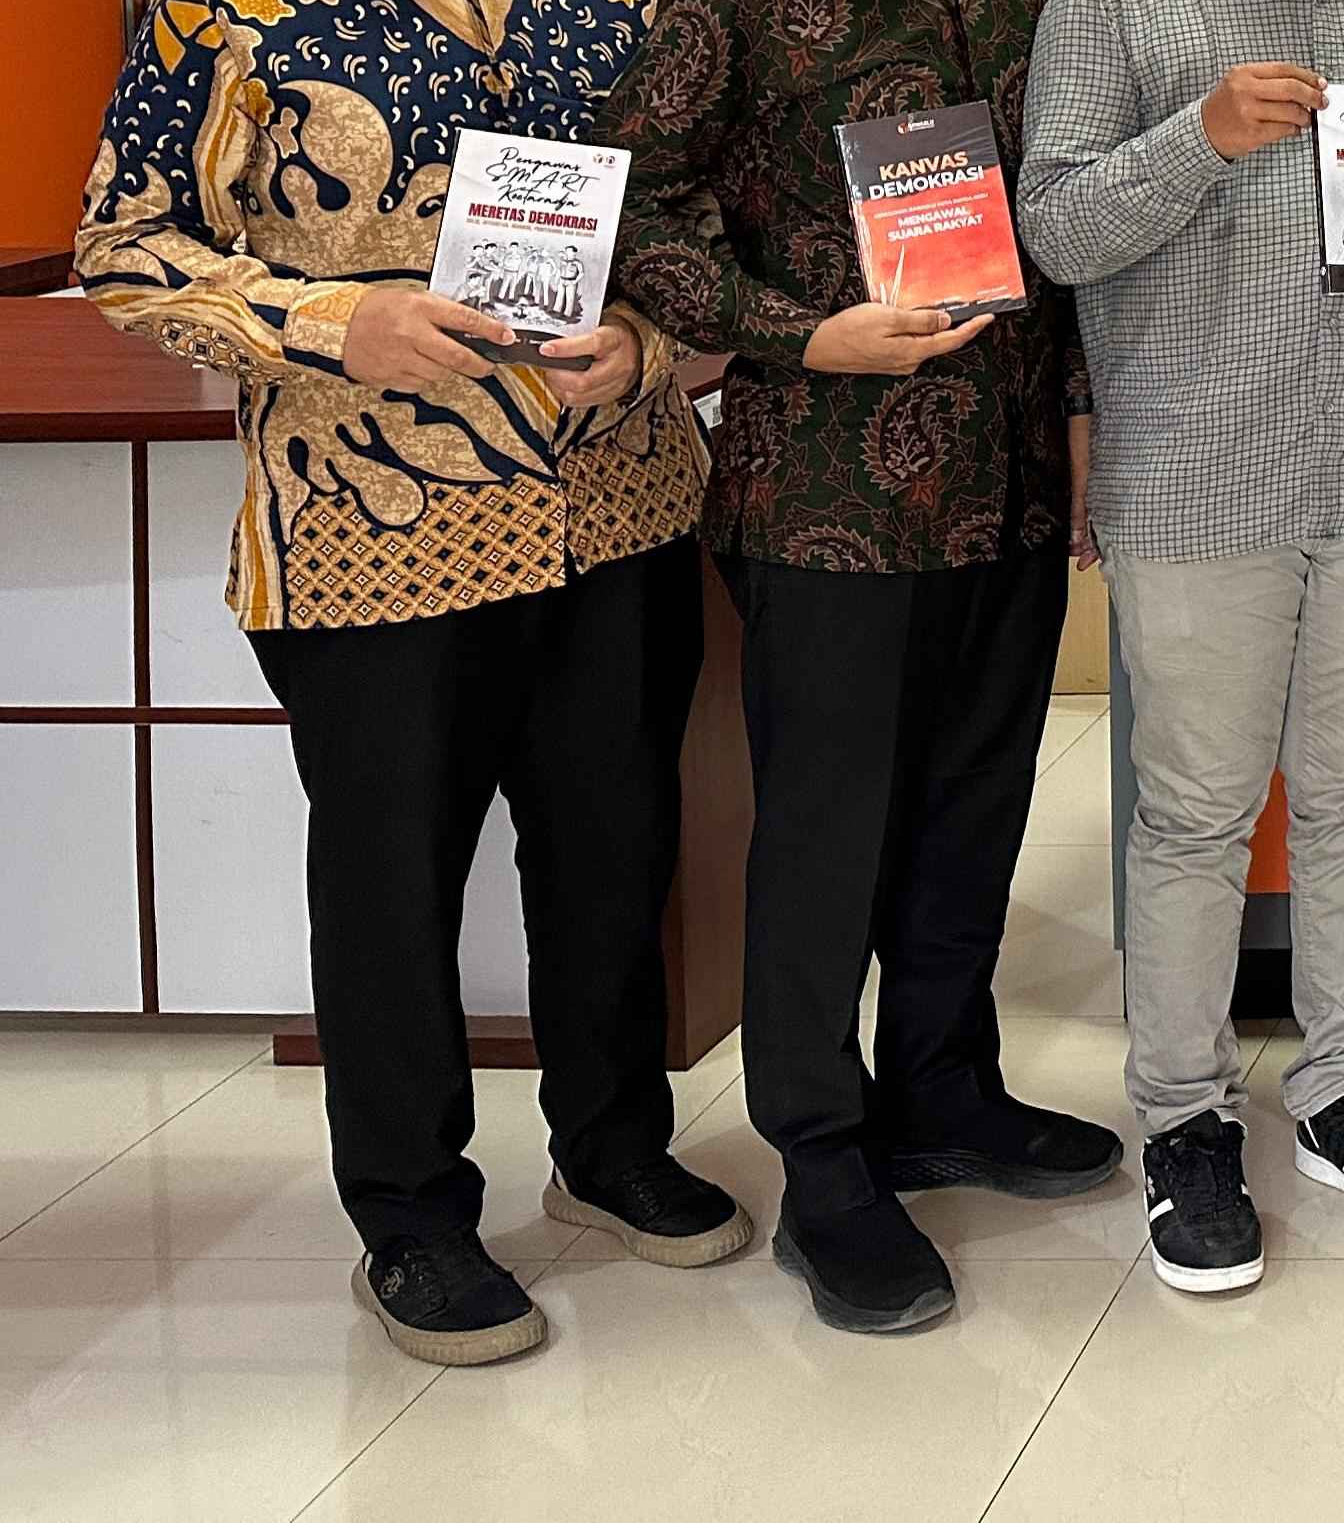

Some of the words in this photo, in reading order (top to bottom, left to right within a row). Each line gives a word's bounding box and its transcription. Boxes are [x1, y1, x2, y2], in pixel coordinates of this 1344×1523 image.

[500, 146, 583, 174] Pengawas
[879, 150, 969, 182] KANVAS
[486, 163, 601, 193] SMART
[868, 165, 985, 200] DEMOKRASI
[468, 202, 526, 223] MERETAS
[528, 210, 599, 232] DEMOKRASI
[887, 224, 933, 243] SUARA
[934, 214, 984, 233] RAKYAT
[897, 206, 970, 229] MENGAWAL
